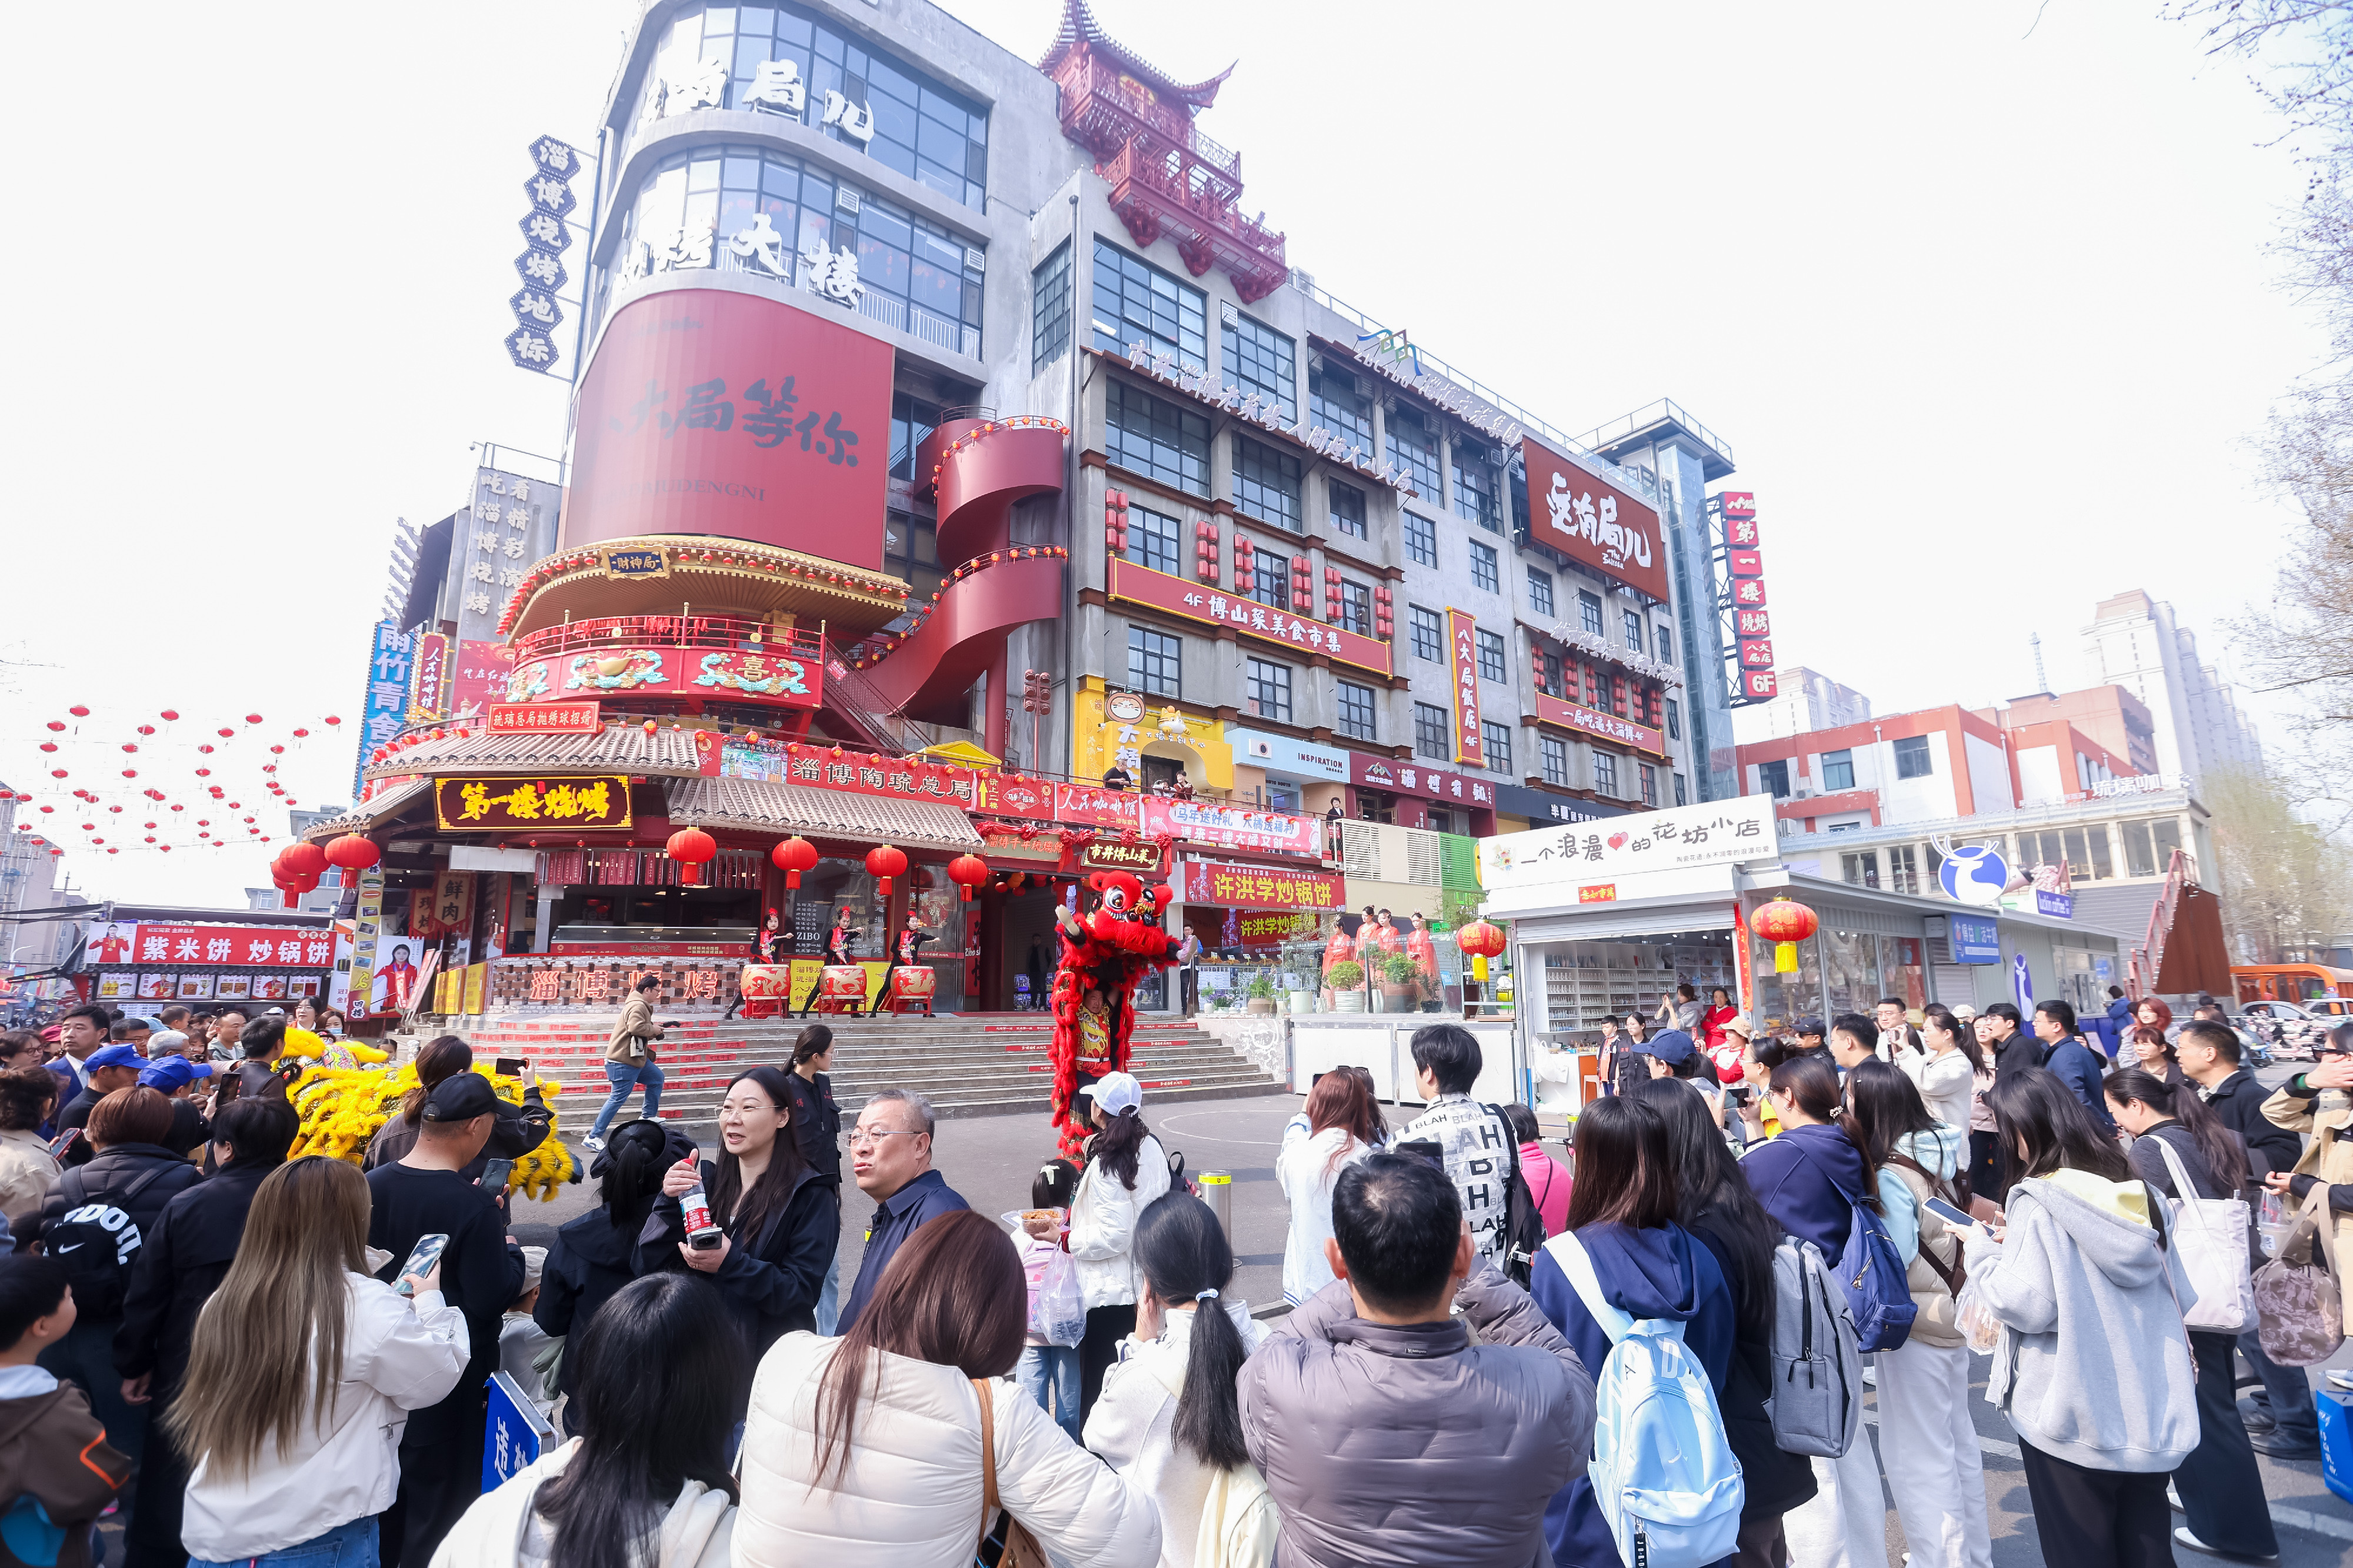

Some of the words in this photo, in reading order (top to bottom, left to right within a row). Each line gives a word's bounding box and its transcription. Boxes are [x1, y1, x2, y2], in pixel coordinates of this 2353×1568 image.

[640, 56, 875, 144] 局儿
[516, 140, 569, 363] 淄博烧烤地标
[465, 472, 506, 615] 吃淄博烧烤
[1608, 549, 1621, 560] The
[618, 557, 656, 570] 財神局
[1602, 553, 1625, 569] Bureau
[1183, 592, 1203, 608] 4F
[1208, 595, 1342, 653] 博山菜美食市集
[364, 622, 410, 756] 雨竹青舍
[1752, 675, 1775, 693] 6F
[493, 711, 592, 728] 琉璃总局抛绣球招婿
[1562, 709, 1634, 742] 一局吃遍大淄博
[1635, 732, 1644, 740] 4F
[1146, 730, 1205, 748] 大橘文创中心
[1465, 736, 1478, 746] 4F
[1298, 752, 1342, 768] INSPIRATION
[792, 757, 973, 800] 淄博陶琉总局
[458, 781, 610, 821] 第一楼烧烤
[989, 778, 998, 810] 请上二楼
[1058, 788, 1138, 817] 人民咖啡馆
[1178, 808, 1233, 826] 马年送好礼
[1089, 843, 1150, 863] 市井博山菜
[442, 879, 464, 922] 鲜肉
[1215, 873, 1332, 906] 许洪学炒锅饼
[797, 932, 820, 940] ZIBO
[142, 936, 232, 961] 紫米饼
[248, 939, 329, 964] 炒锅饼
[531, 970, 718, 999] 淄博烧烤
[353, 1000, 365, 1019] 四楼
[1415, 1115, 1447, 1129] BLAH
[1452, 1113, 1482, 1125] BLAH
[74, 1203, 129, 1230] DO
